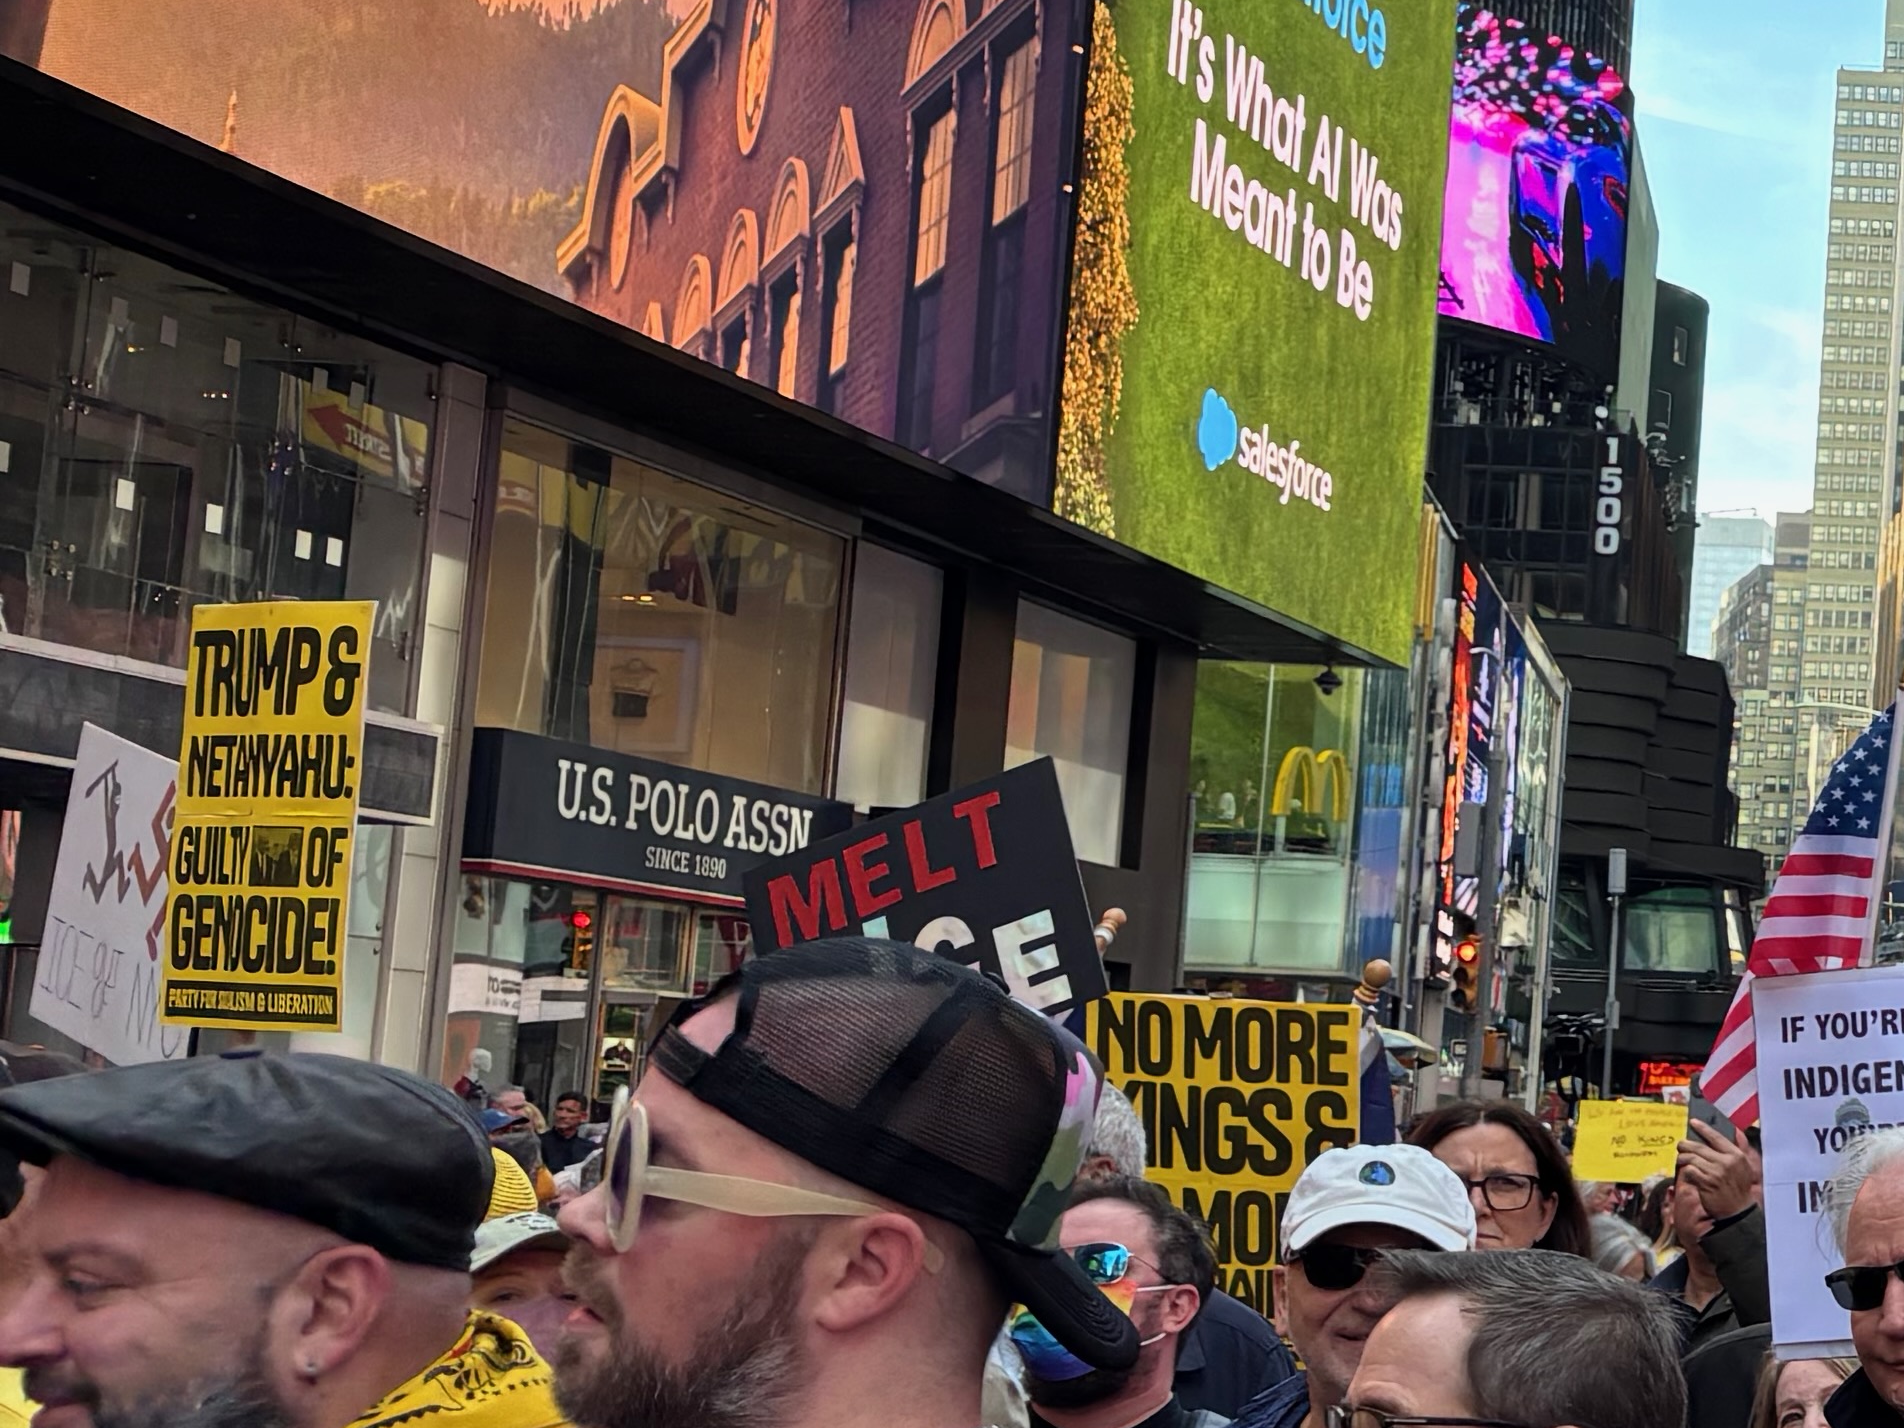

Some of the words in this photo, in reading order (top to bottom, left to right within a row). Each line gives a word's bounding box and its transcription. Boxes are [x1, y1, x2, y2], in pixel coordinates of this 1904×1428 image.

[1225, 33, 1307, 175] What
[1309, 114, 1341, 204] AI
[1348, 137, 1404, 252] Was
[1190, 119, 1297, 269] Meant
[1300, 200, 1330, 292] to
[1337, 228, 1374, 322] Be
[1237, 424, 1333, 512] salesforce
[1593, 436, 1624, 556] 1500
[193, 626, 322, 717] TRUMP
[323, 626, 362, 717] &
[558, 759, 617, 827] U.S.
[625, 773, 719, 844] POLO
[724, 795, 813, 856] ASSN
[175, 825, 250, 885] GUILTY
[307, 826, 349, 887] OF
[645, 846, 689, 873] SINCE
[695, 854, 727, 879] 1890
[767, 791, 1000, 949] MELT
[171, 893, 341, 976] GENOCIDE!
[1100, 997, 1172, 1076] NO
[1183, 1005, 1349, 1087] MORE
[1781, 1016, 1805, 1043] IF
